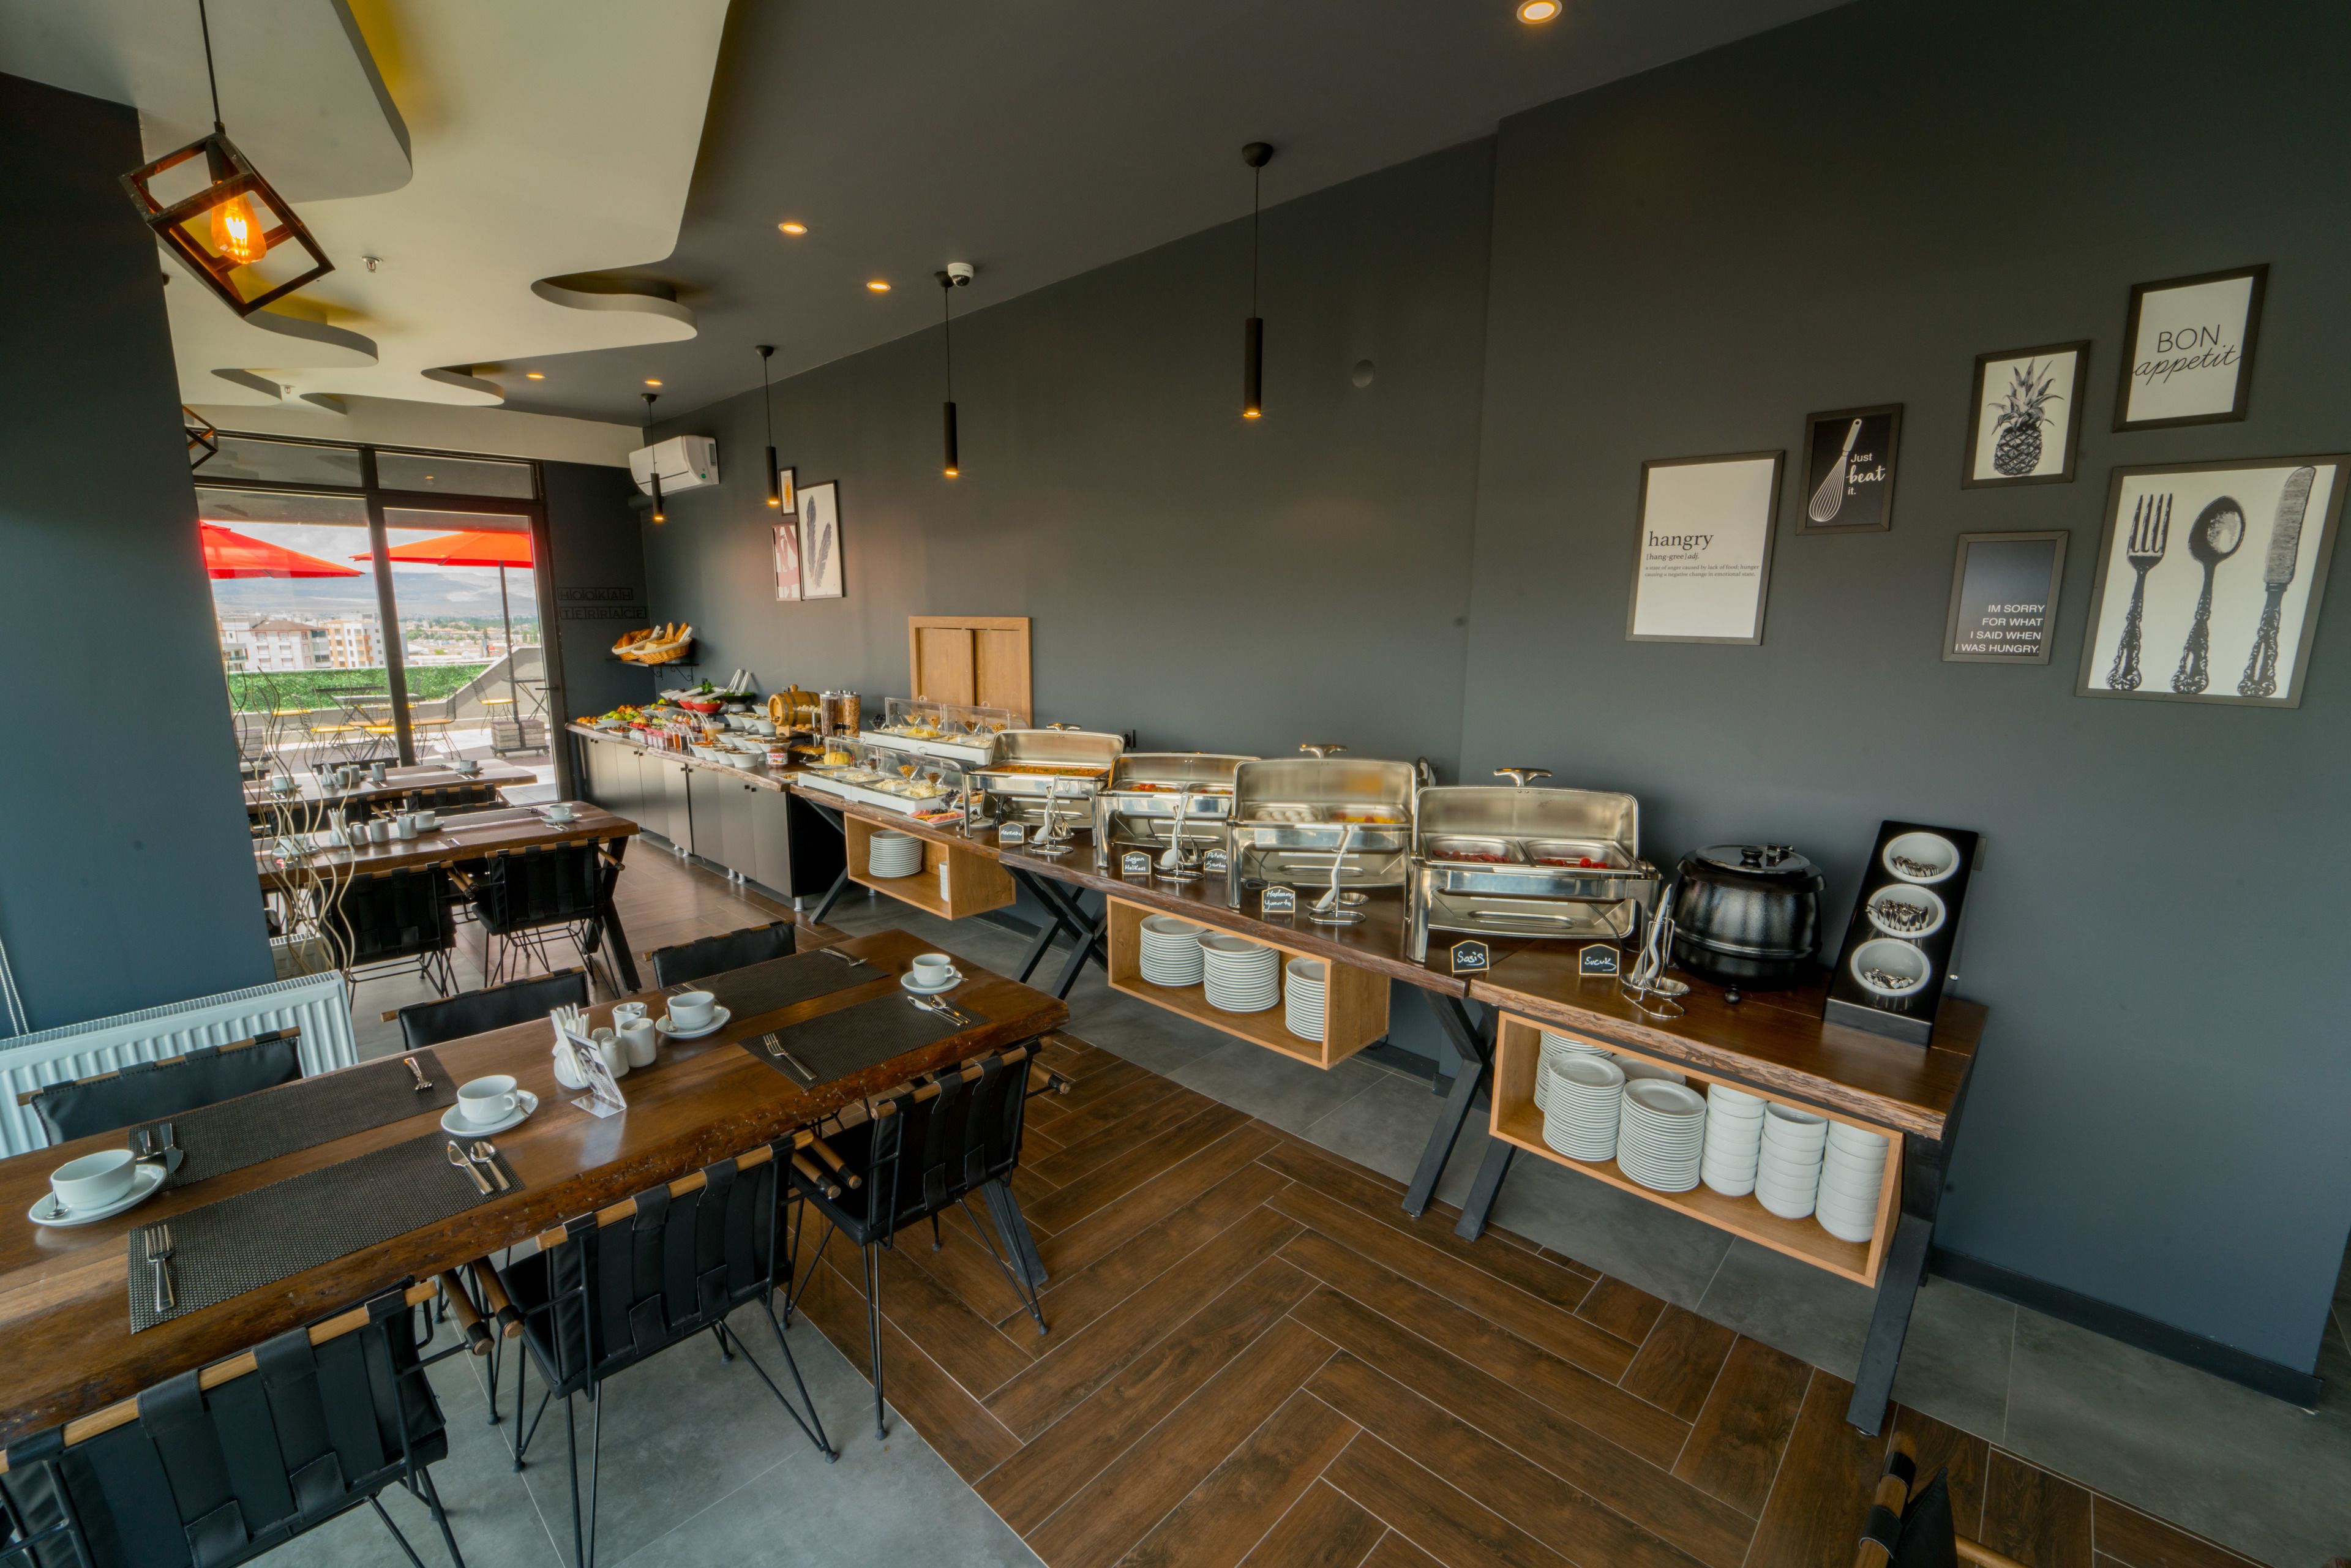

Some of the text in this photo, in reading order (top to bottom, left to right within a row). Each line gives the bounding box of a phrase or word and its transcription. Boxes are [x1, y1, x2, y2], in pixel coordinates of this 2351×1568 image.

[2157, 324, 2221, 353] BON
[2132, 344, 2241, 386] appetit
[1850, 452, 1873, 463] Just
[1845, 464, 1886, 484] beat
[1848, 487, 1856, 495] it.
[1648, 531, 1714, 551] hangry
[560, 590, 631, 599] HOOKAH
[1988, 604, 2045, 613] IM SORRY
[562, 609, 643, 618] TERRACE
[1982, 618, 2044, 626] FOR WHAT
[2006, 631, 2041, 640] WHEN
[1989, 645, 2040, 653] HUNGRY.
